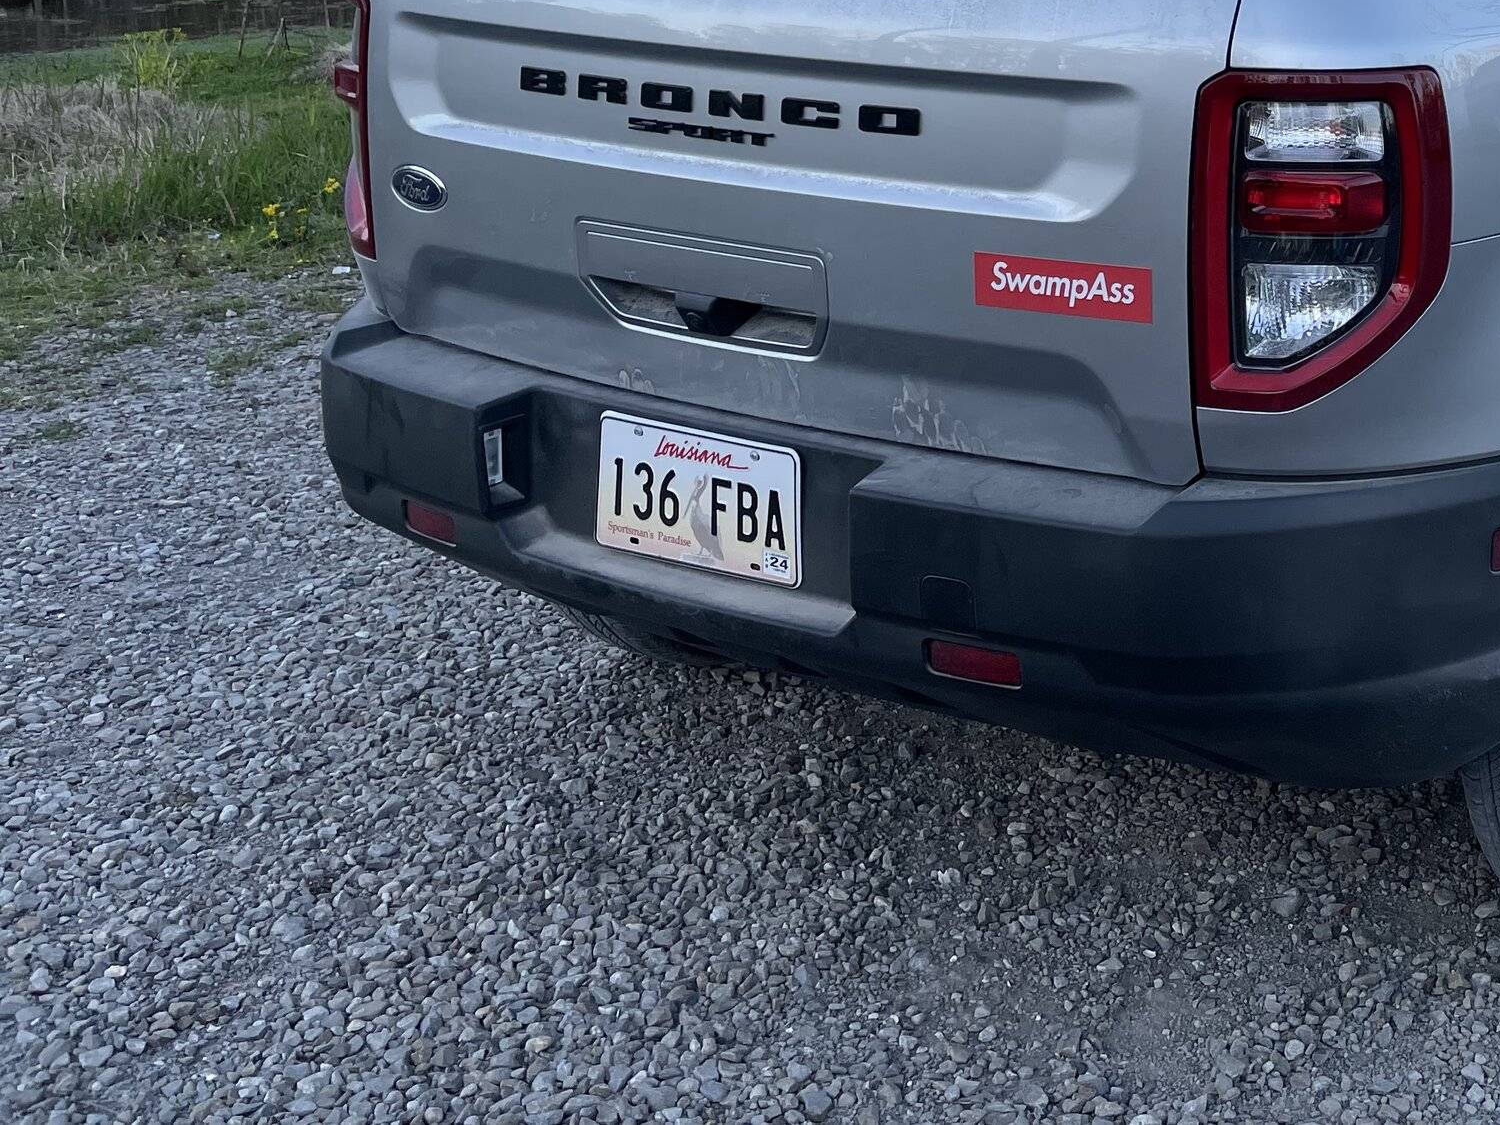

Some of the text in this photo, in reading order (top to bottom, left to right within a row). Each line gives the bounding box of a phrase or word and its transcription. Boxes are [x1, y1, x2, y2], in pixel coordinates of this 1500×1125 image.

[520, 65, 921, 136] BRONCO
[628, 117, 775, 146] SPORT
[400, 174, 430, 202] Ford
[990, 261, 1135, 308] SwampAss
[654, 434, 749, 470] Louisiana
[614, 457, 786, 551] 136 FBA
[608, 521, 692, 547] Sportsman's Paradise
[770, 556, 789, 570] 24
